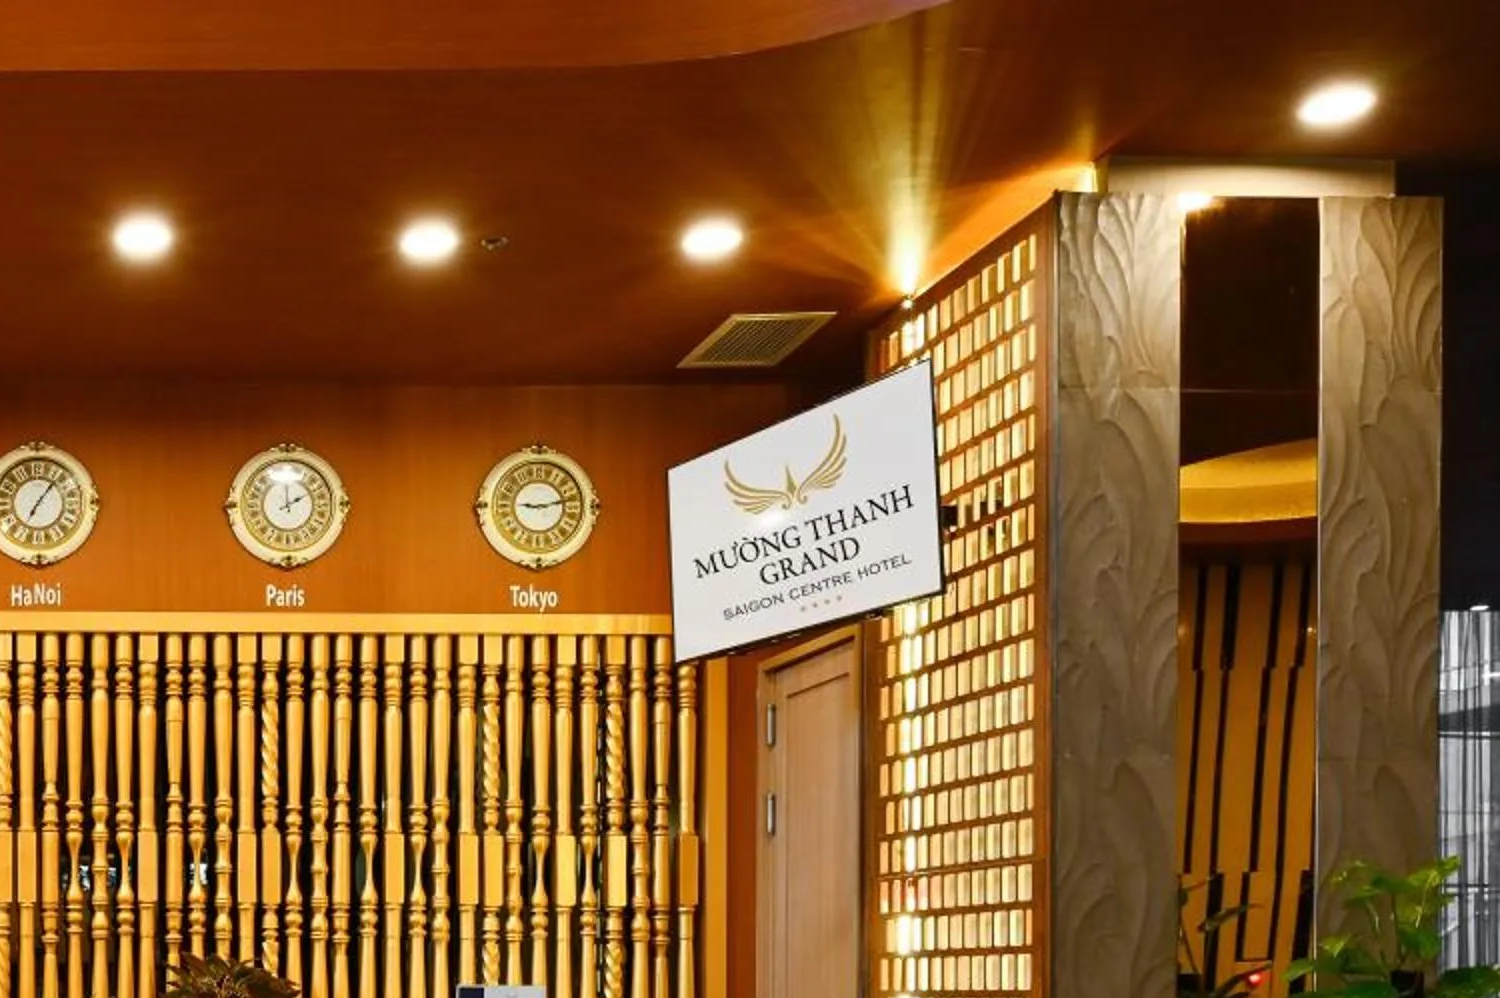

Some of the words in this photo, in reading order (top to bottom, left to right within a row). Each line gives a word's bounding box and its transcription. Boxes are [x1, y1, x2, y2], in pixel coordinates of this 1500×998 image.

[694, 525, 801, 579] MƯỜNG
[804, 484, 915, 544] THANH
[759, 537, 861, 586] GRAND
[11, 583, 62, 607] HaNoi
[265, 584, 305, 607] Paris
[509, 584, 558, 613] Tokyo
[723, 594, 785, 621] SAIGON
[788, 572, 853, 601] CENTRE
[857, 552, 913, 580] HOTEL
